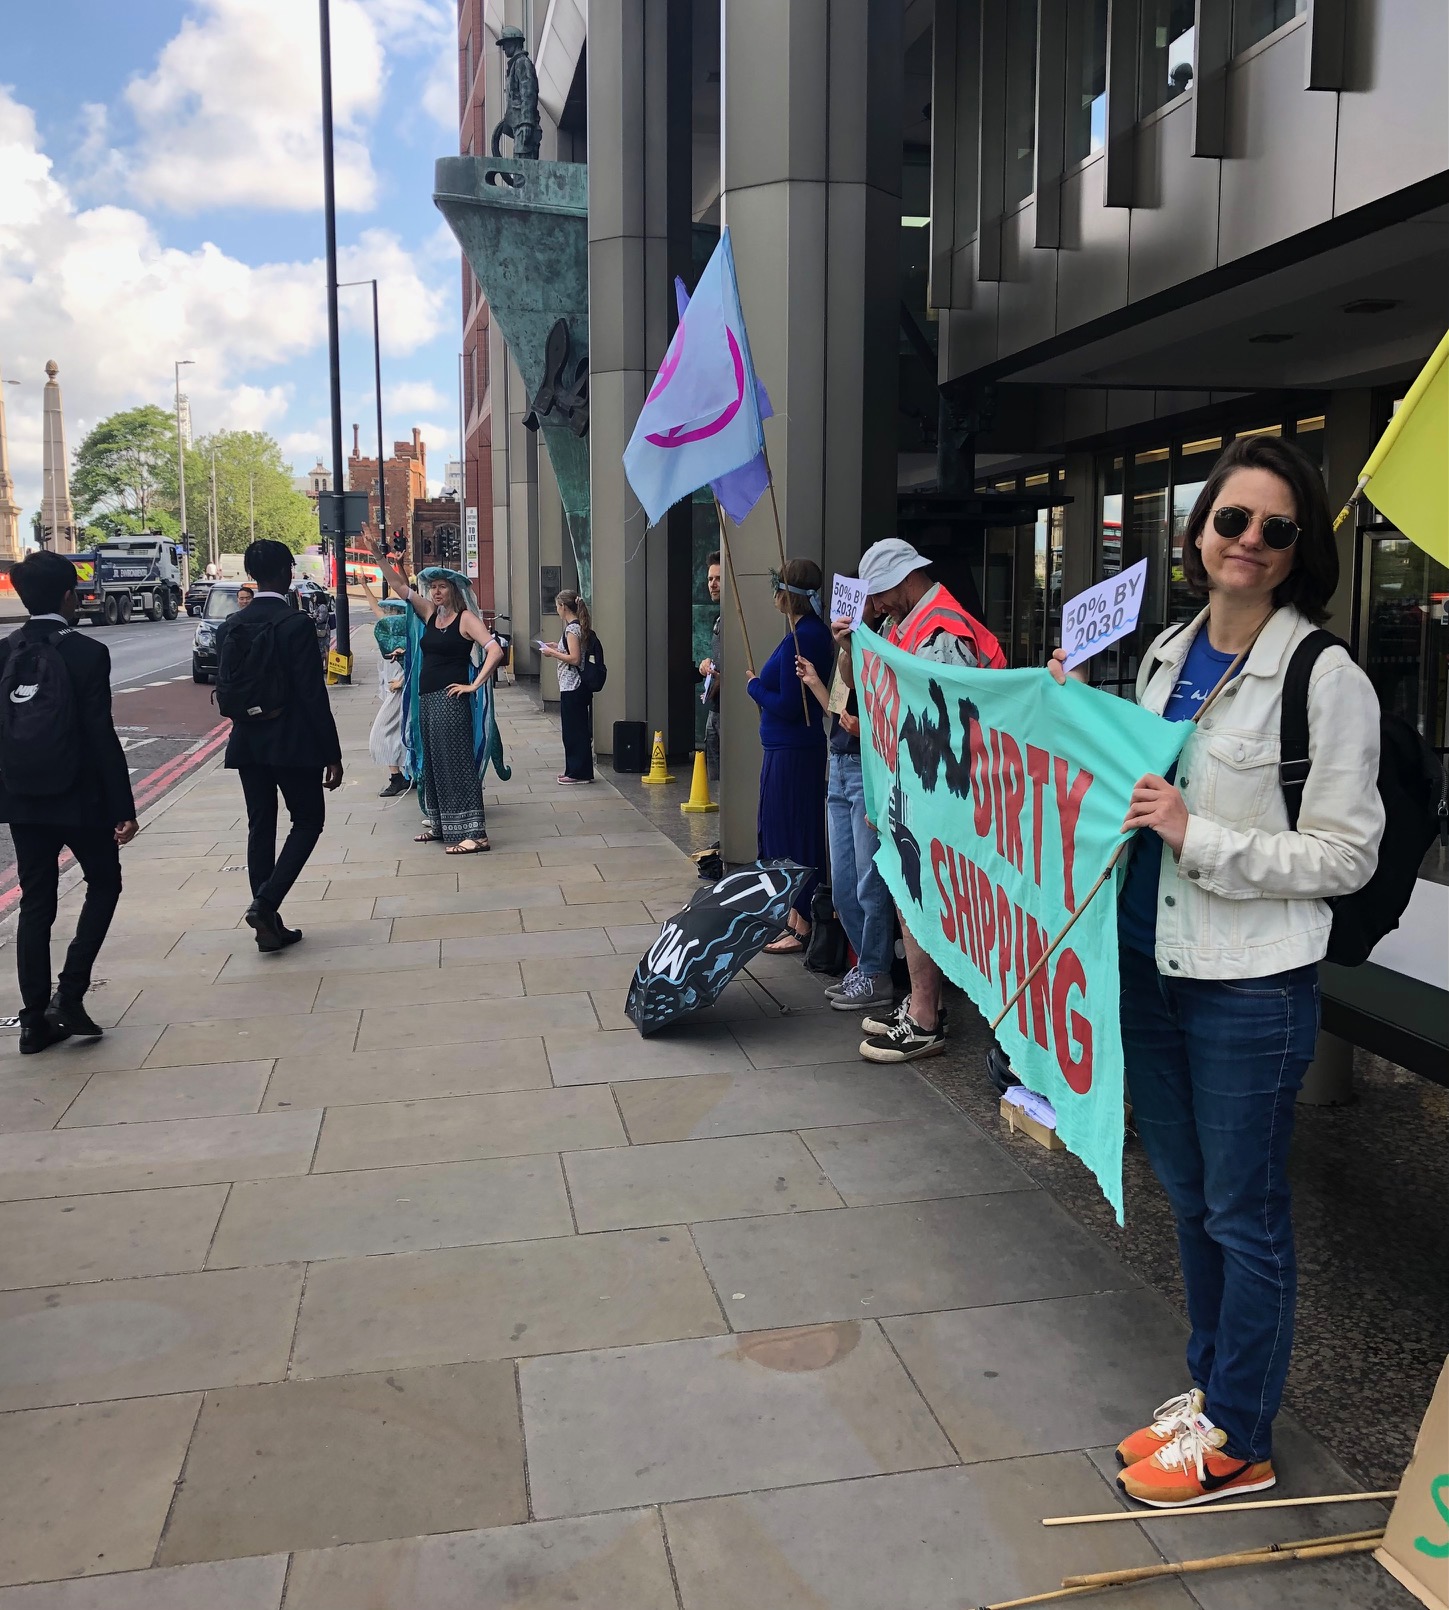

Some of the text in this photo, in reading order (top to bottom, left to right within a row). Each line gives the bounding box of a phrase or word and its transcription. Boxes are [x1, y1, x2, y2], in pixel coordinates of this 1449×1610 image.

[468, 534, 476, 542] LET
[833, 581, 866, 606] 50% BY
[836, 599, 857, 620] 2030
[1065, 572, 1143, 633] 50% BY
[1074, 607, 1124, 652] 2030
[969, 716, 1094, 914] DIRTY
[930, 837, 1094, 1096] SHIPPING
